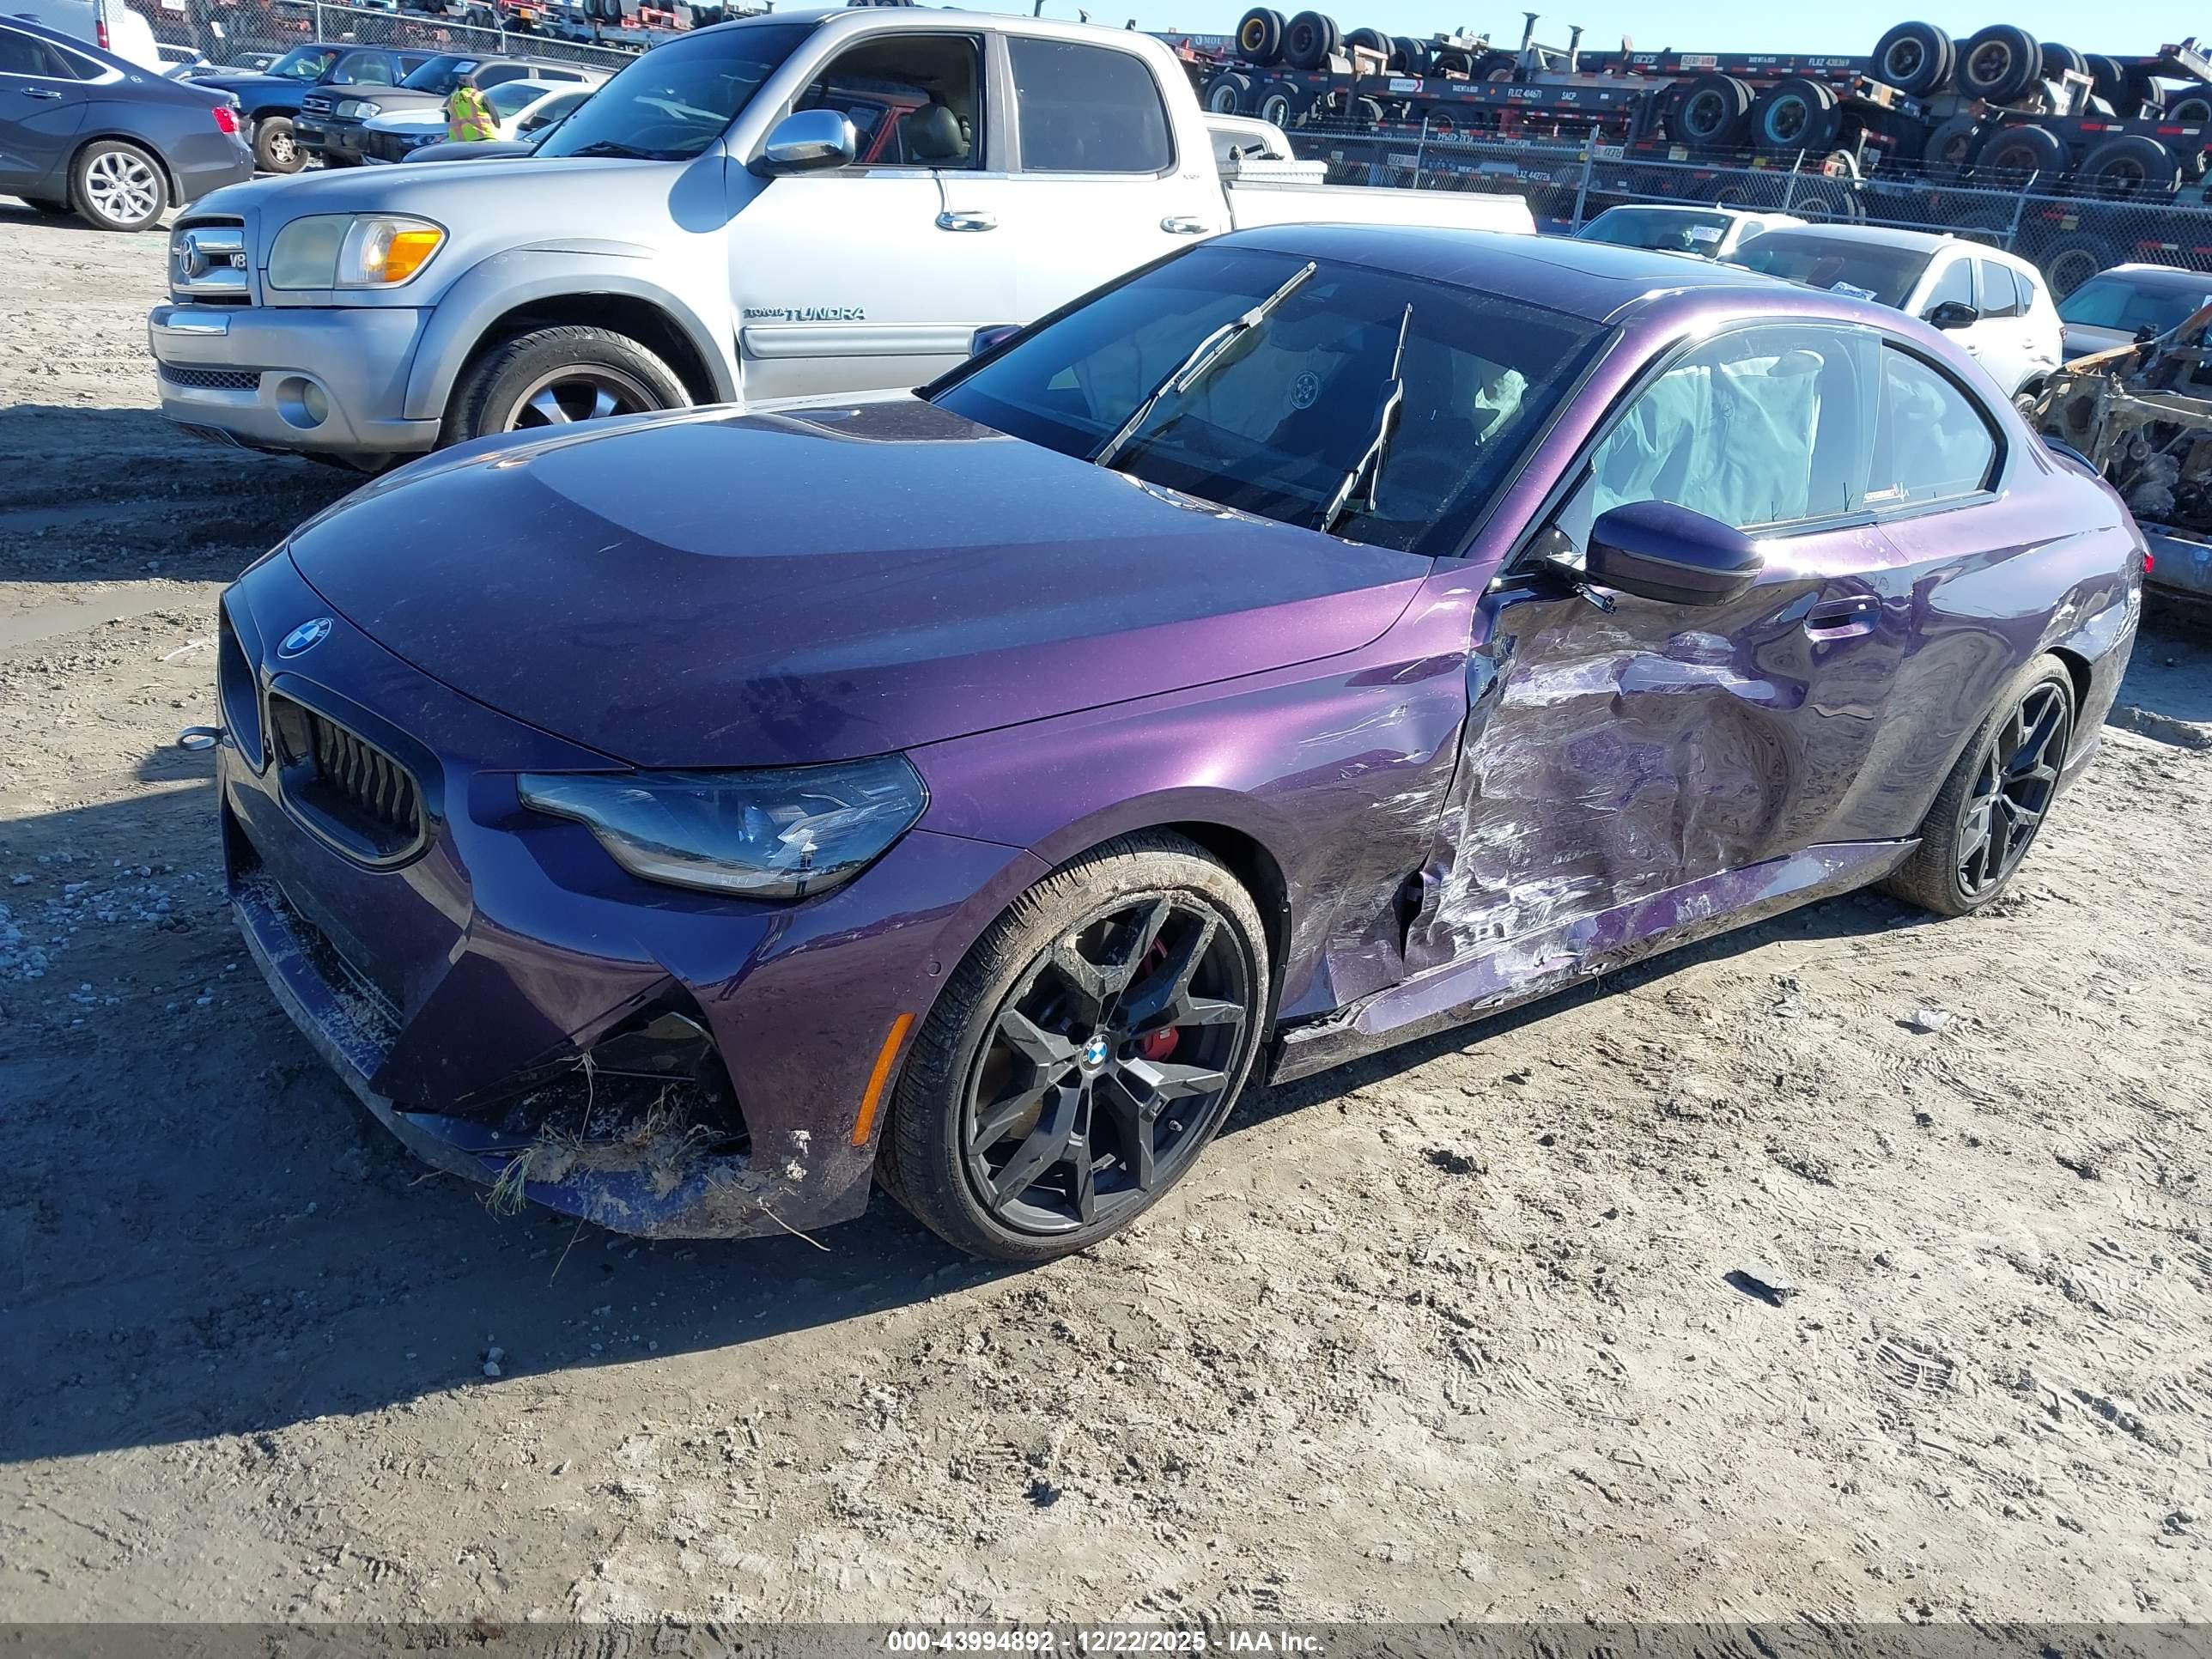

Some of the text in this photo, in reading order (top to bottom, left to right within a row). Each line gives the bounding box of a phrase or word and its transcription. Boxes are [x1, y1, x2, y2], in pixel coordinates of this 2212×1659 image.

[229, 253, 246, 268] V8
[746, 307, 865, 321] TOYOTA TUNDRA
